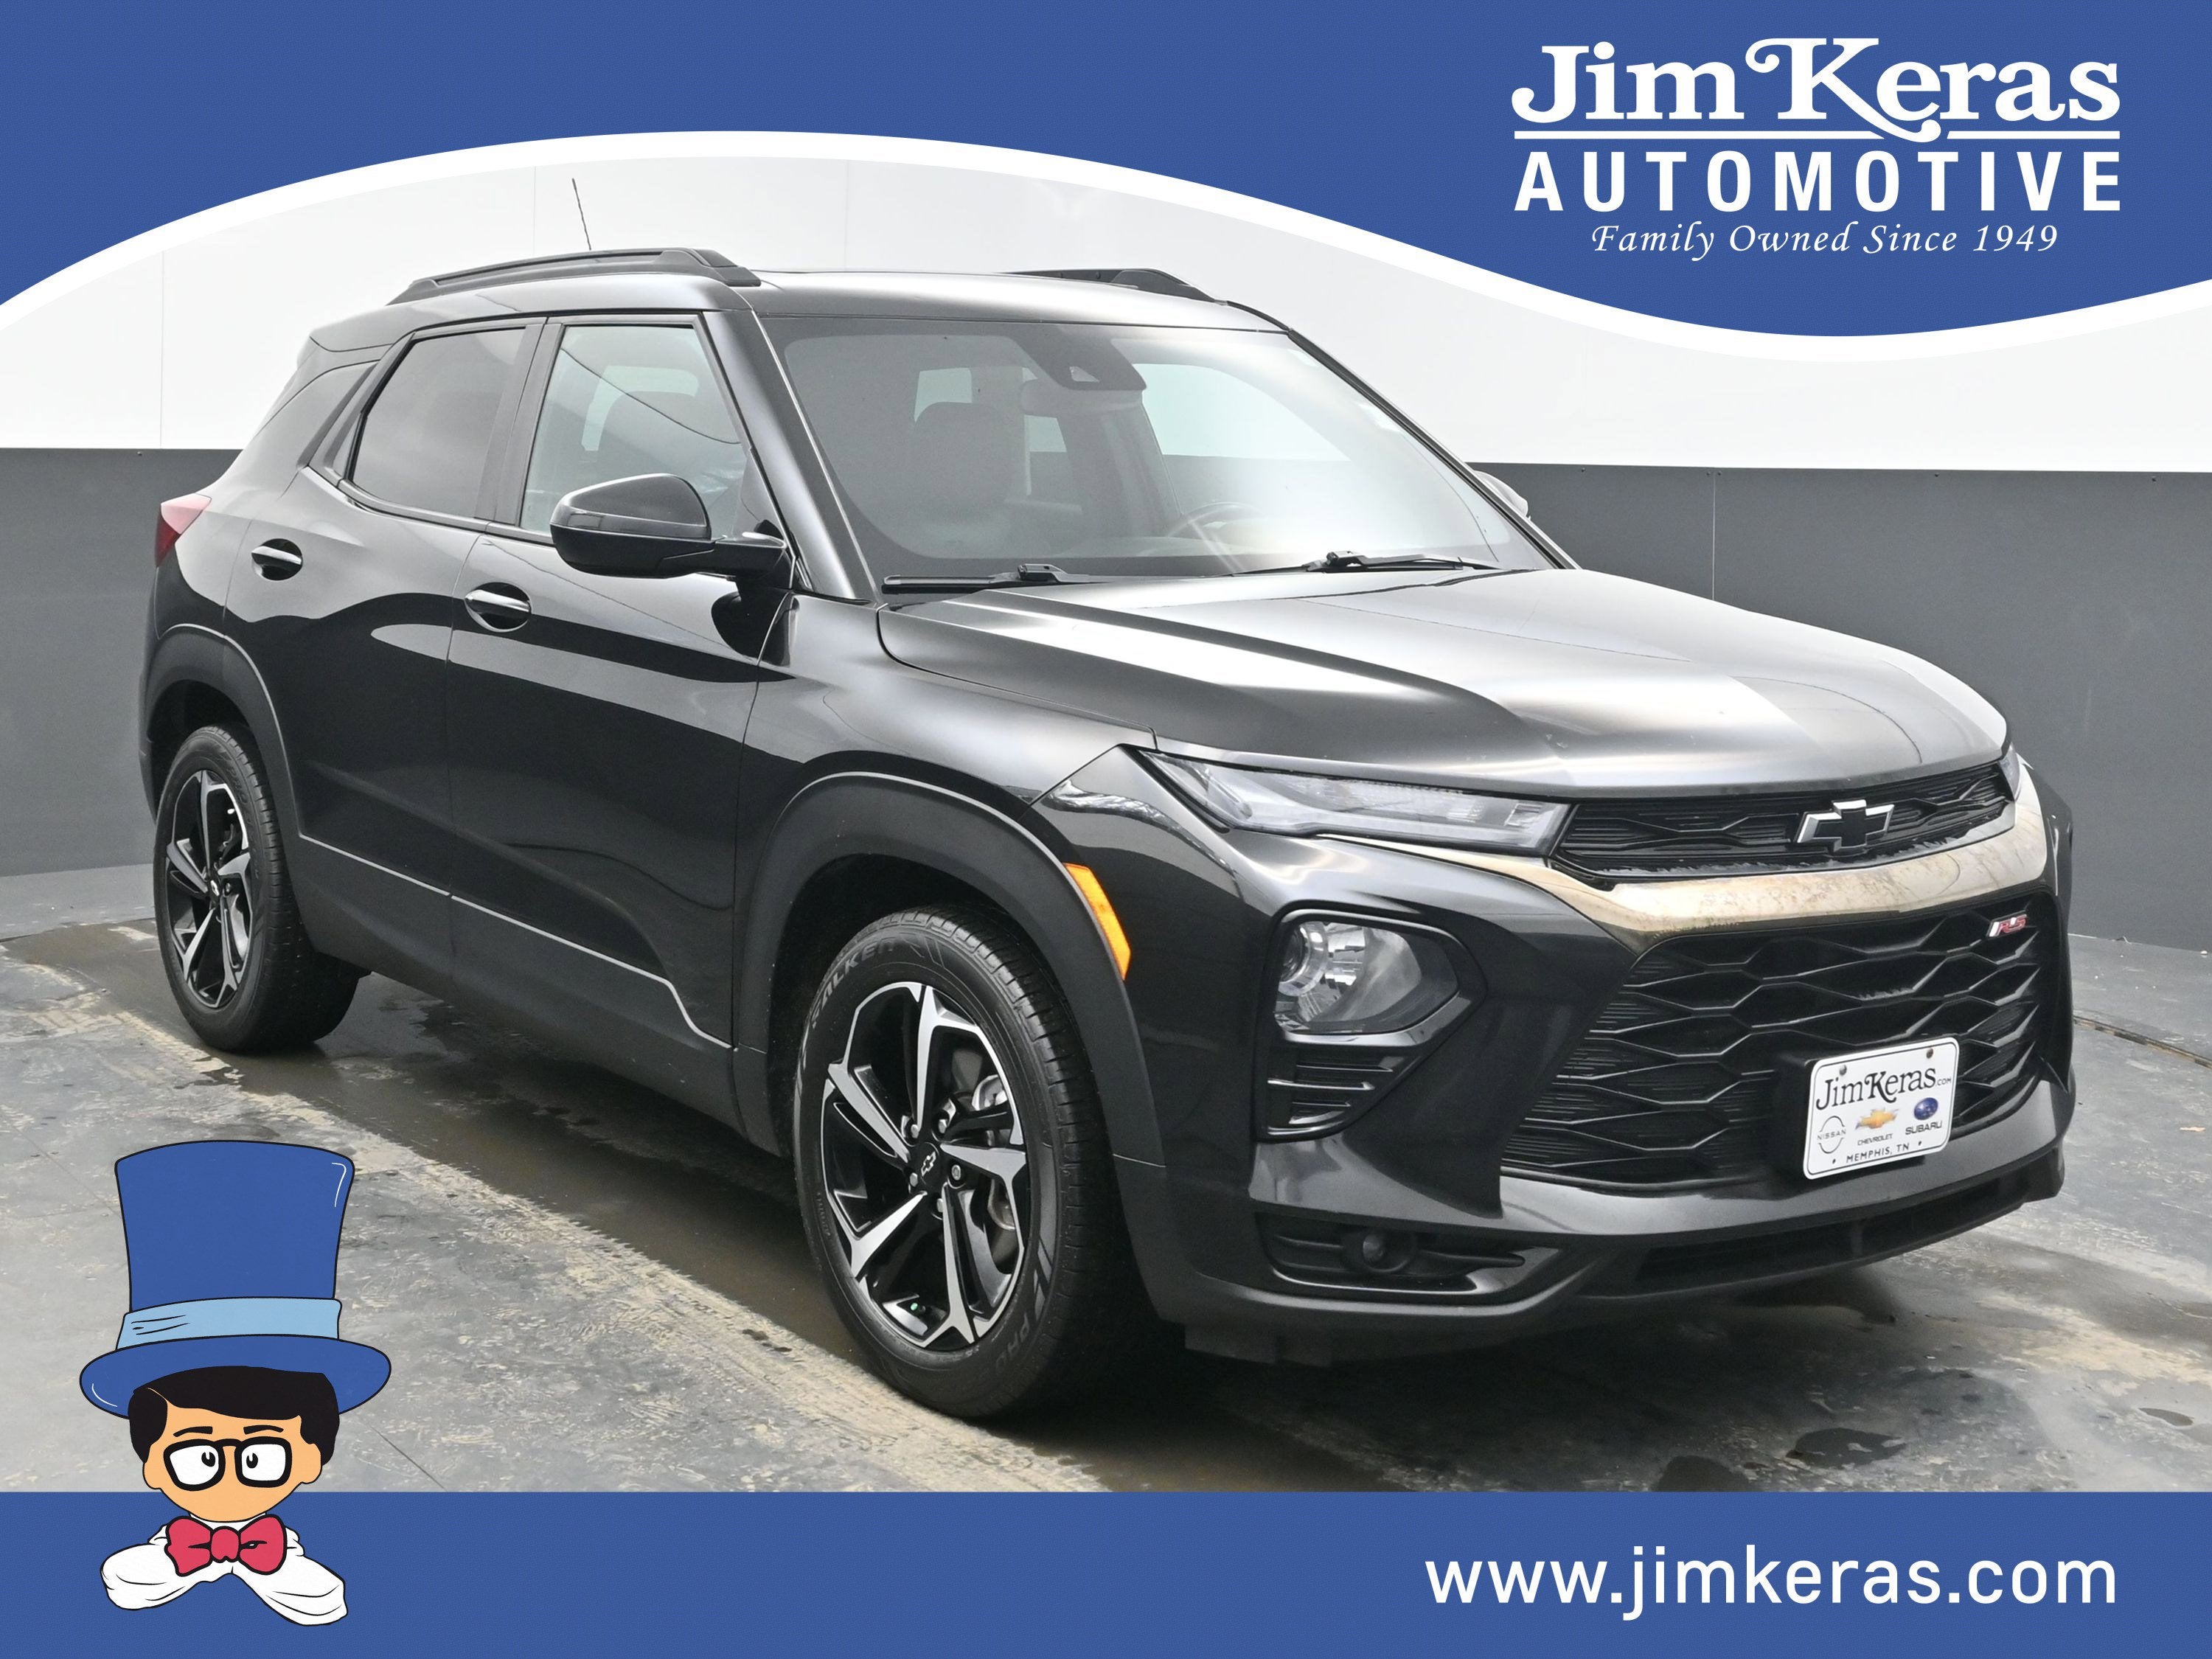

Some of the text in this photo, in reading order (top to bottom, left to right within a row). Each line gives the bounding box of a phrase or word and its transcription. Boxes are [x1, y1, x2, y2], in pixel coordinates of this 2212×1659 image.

[1989, 914, 2027, 937] RS
[1817, 1129, 1846, 1141] NISSAN
[1905, 1121, 1942, 1135] SUBARU
[1857, 1133, 1893, 1146] CHEVROLET
[1846, 1144, 1910, 1164] MEMPHIS, TN
